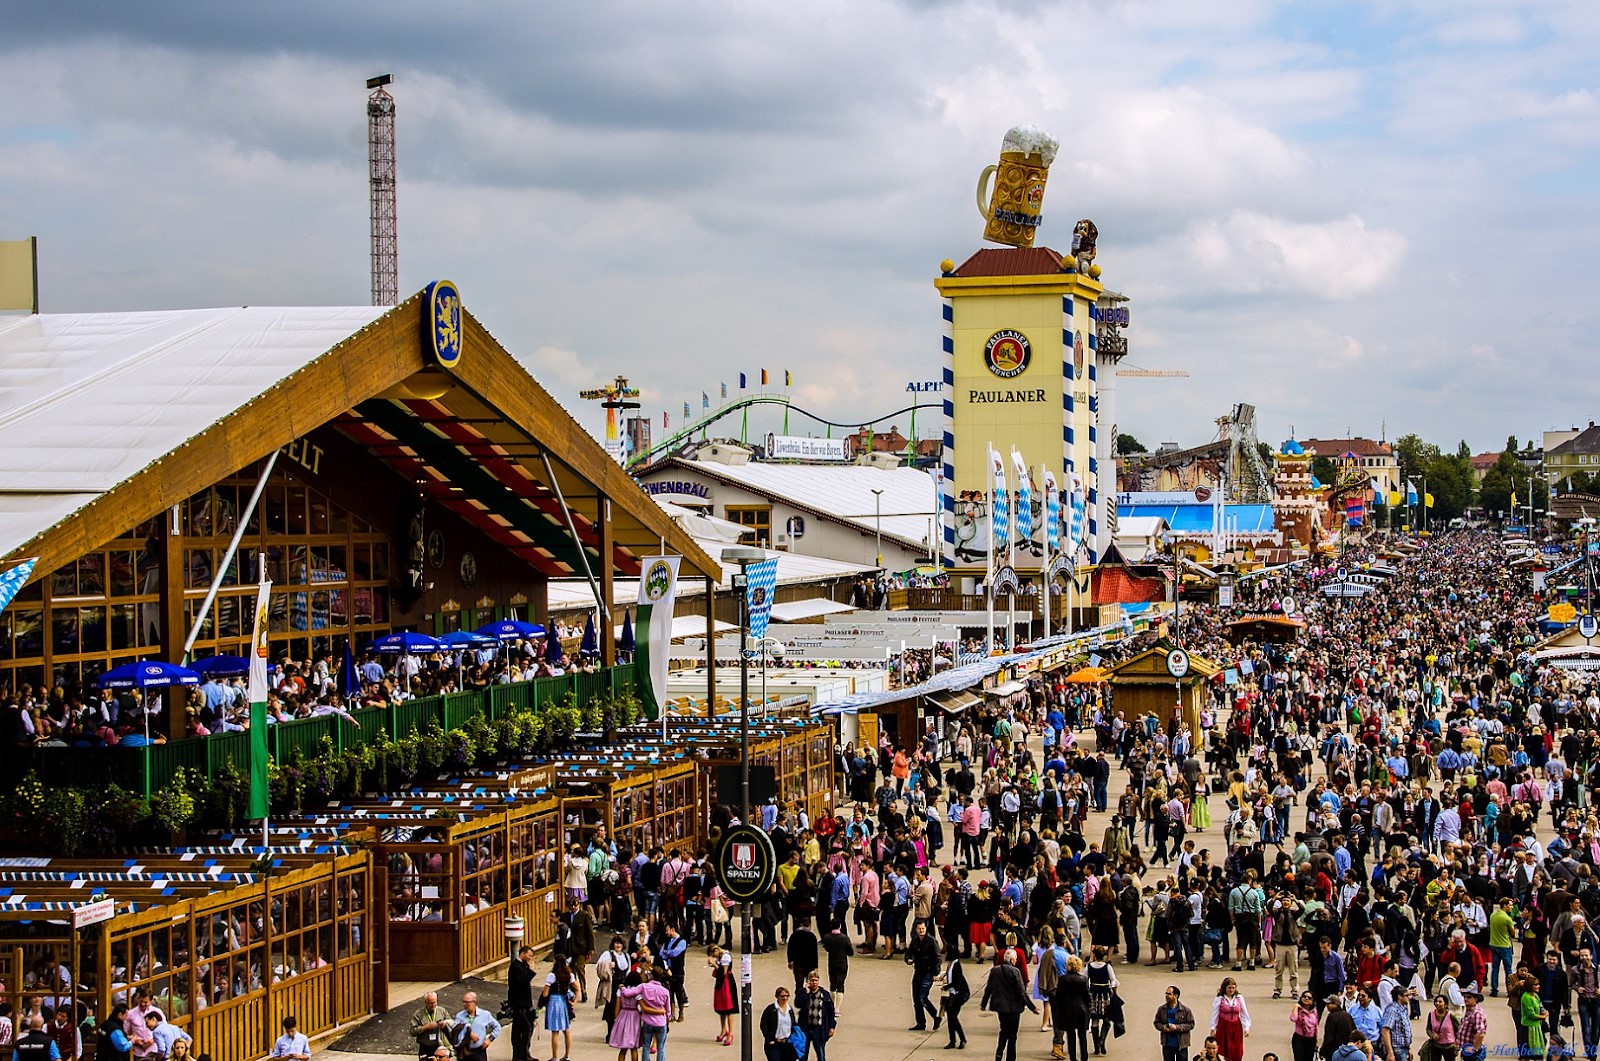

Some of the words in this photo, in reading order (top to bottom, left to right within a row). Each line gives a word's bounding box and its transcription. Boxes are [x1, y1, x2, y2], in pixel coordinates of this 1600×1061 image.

[986, 330, 1029, 350] PAULANER
[969, 389, 1047, 404] PAULANER
[727, 870, 760, 878] SPATEN
